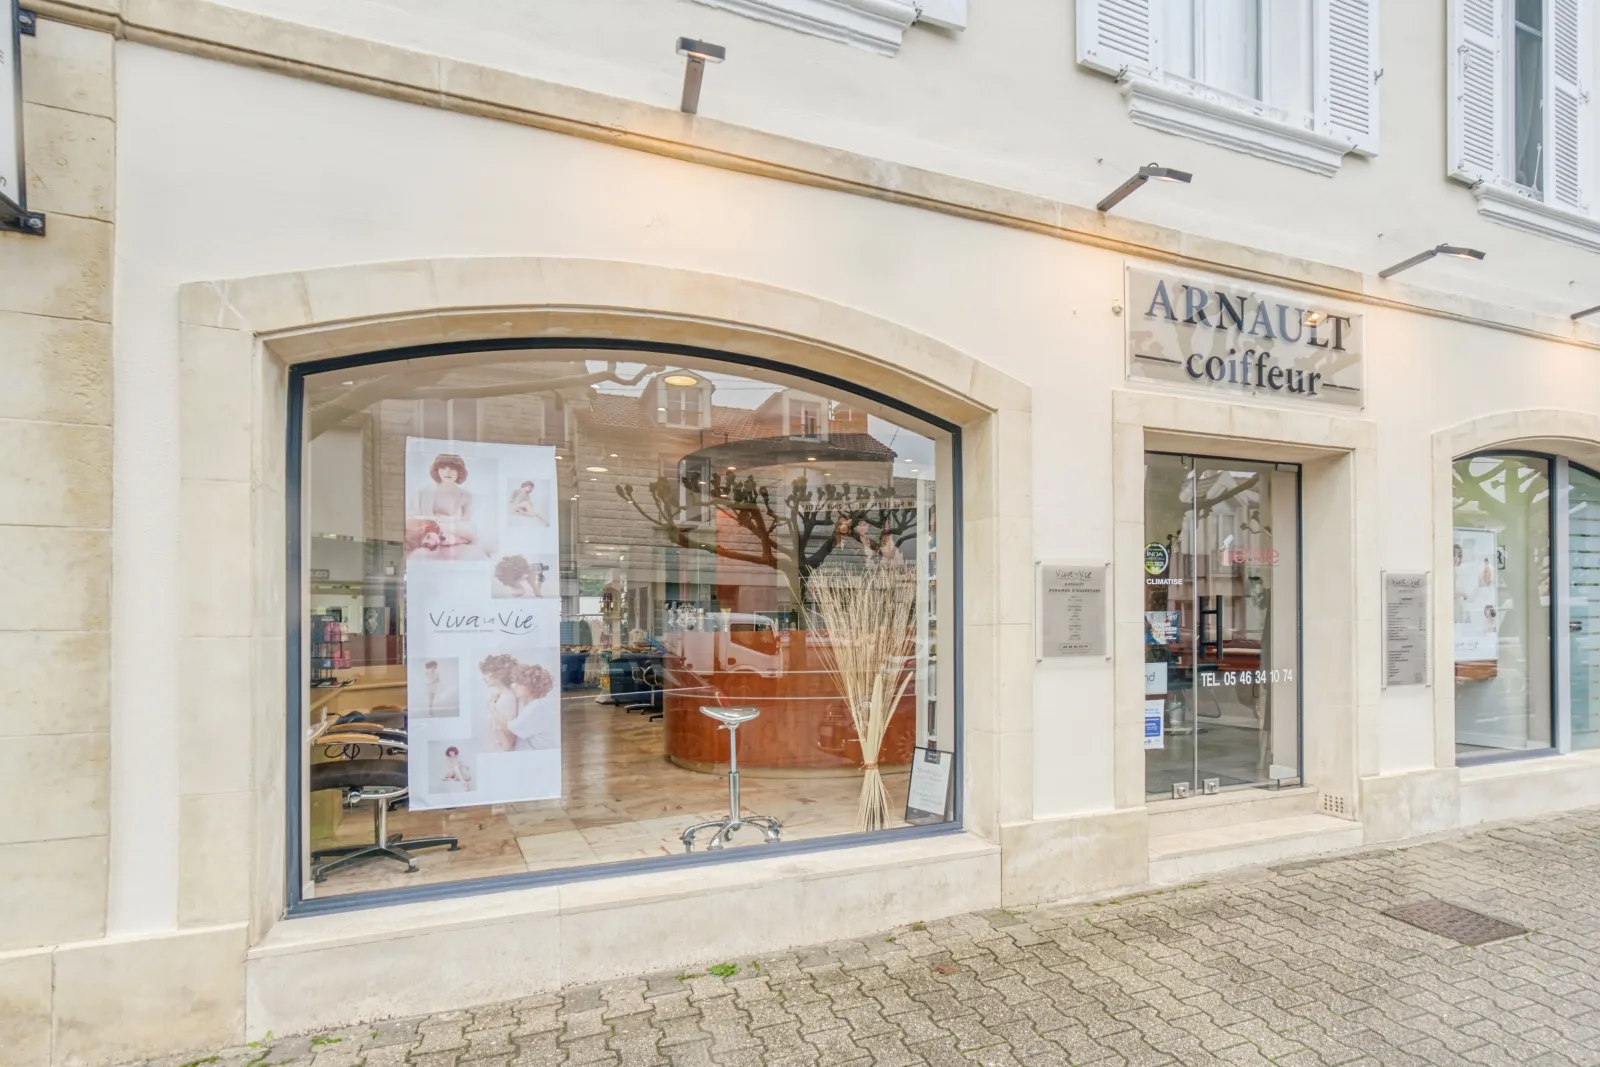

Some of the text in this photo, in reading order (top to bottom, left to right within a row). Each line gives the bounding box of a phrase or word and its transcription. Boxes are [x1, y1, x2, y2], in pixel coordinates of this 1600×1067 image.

[1144, 279, 1350, 351] ARNAULT
[1186, 347, 1321, 395] coiffeur
[429, 609, 480, 628] Viva
[498, 609, 533, 629] Vie
[1201, 669, 1293, 686] TEL. 05 46 34 10 74
